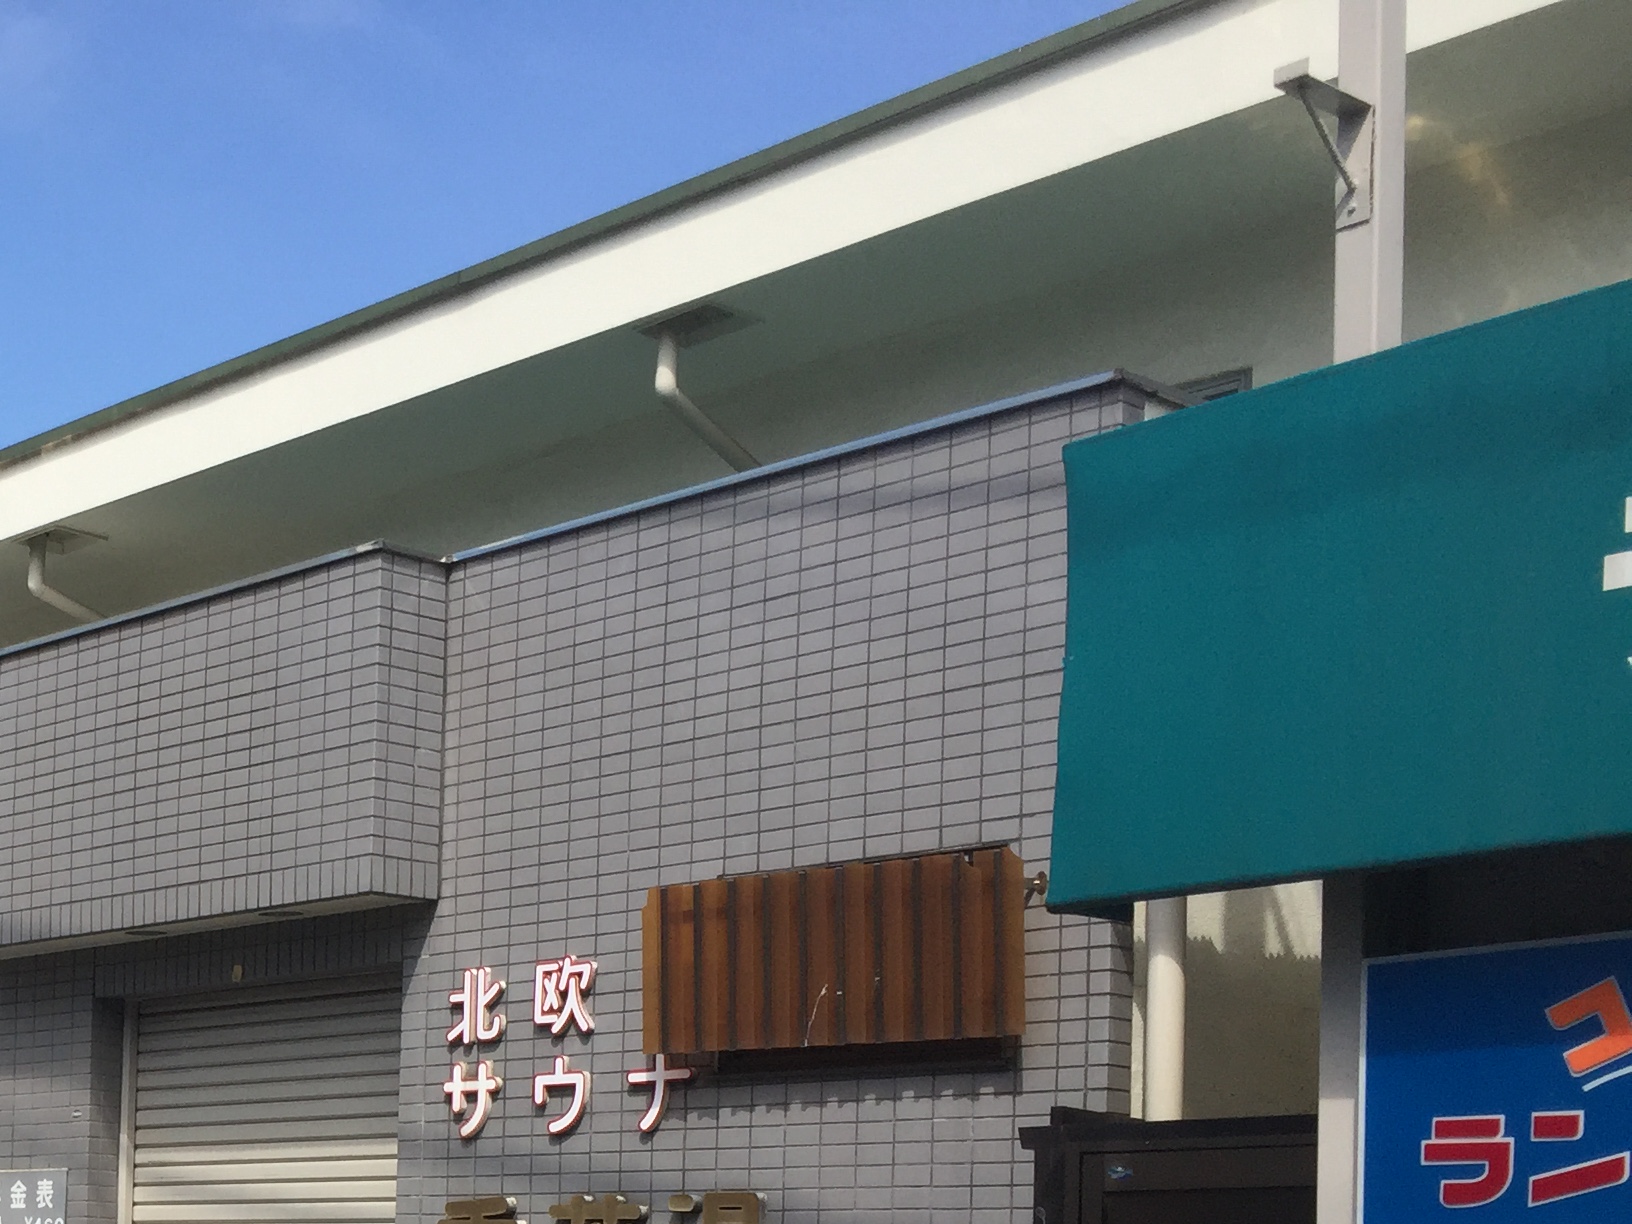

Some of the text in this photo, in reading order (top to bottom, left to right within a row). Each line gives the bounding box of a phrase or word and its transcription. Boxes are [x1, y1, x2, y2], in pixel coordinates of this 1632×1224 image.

[446, 955, 598, 1045] 北欧
[443, 1054, 697, 1138] サウナ
[1420, 1109, 1631, 1209] ラン
